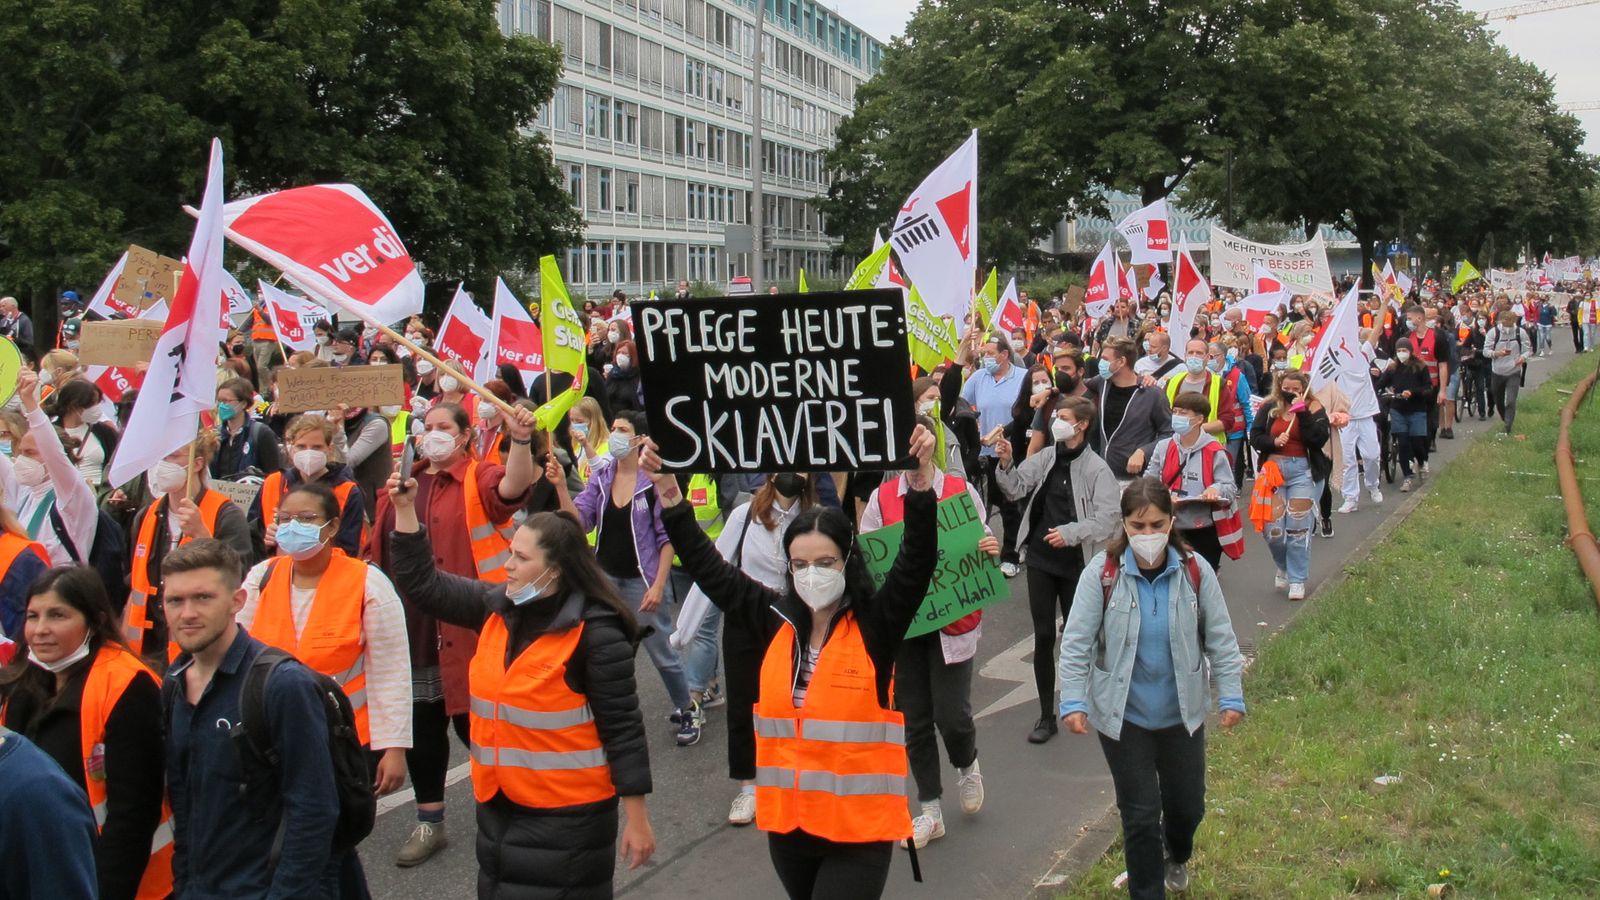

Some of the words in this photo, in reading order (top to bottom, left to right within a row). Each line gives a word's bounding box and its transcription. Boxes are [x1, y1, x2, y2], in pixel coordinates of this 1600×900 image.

[320, 226, 406, 283] ver.di
[1223, 240, 1257, 254] MEHR
[1269, 259, 1314, 270] BESSER
[642, 307, 757, 363] PFLEGE
[780, 305, 904, 354] HEUTE:
[704, 358, 863, 399] MODERNE
[661, 396, 896, 468] SKLAVEREI
[926, 600, 953, 622] der
[953, 571, 996, 610] Wahl
